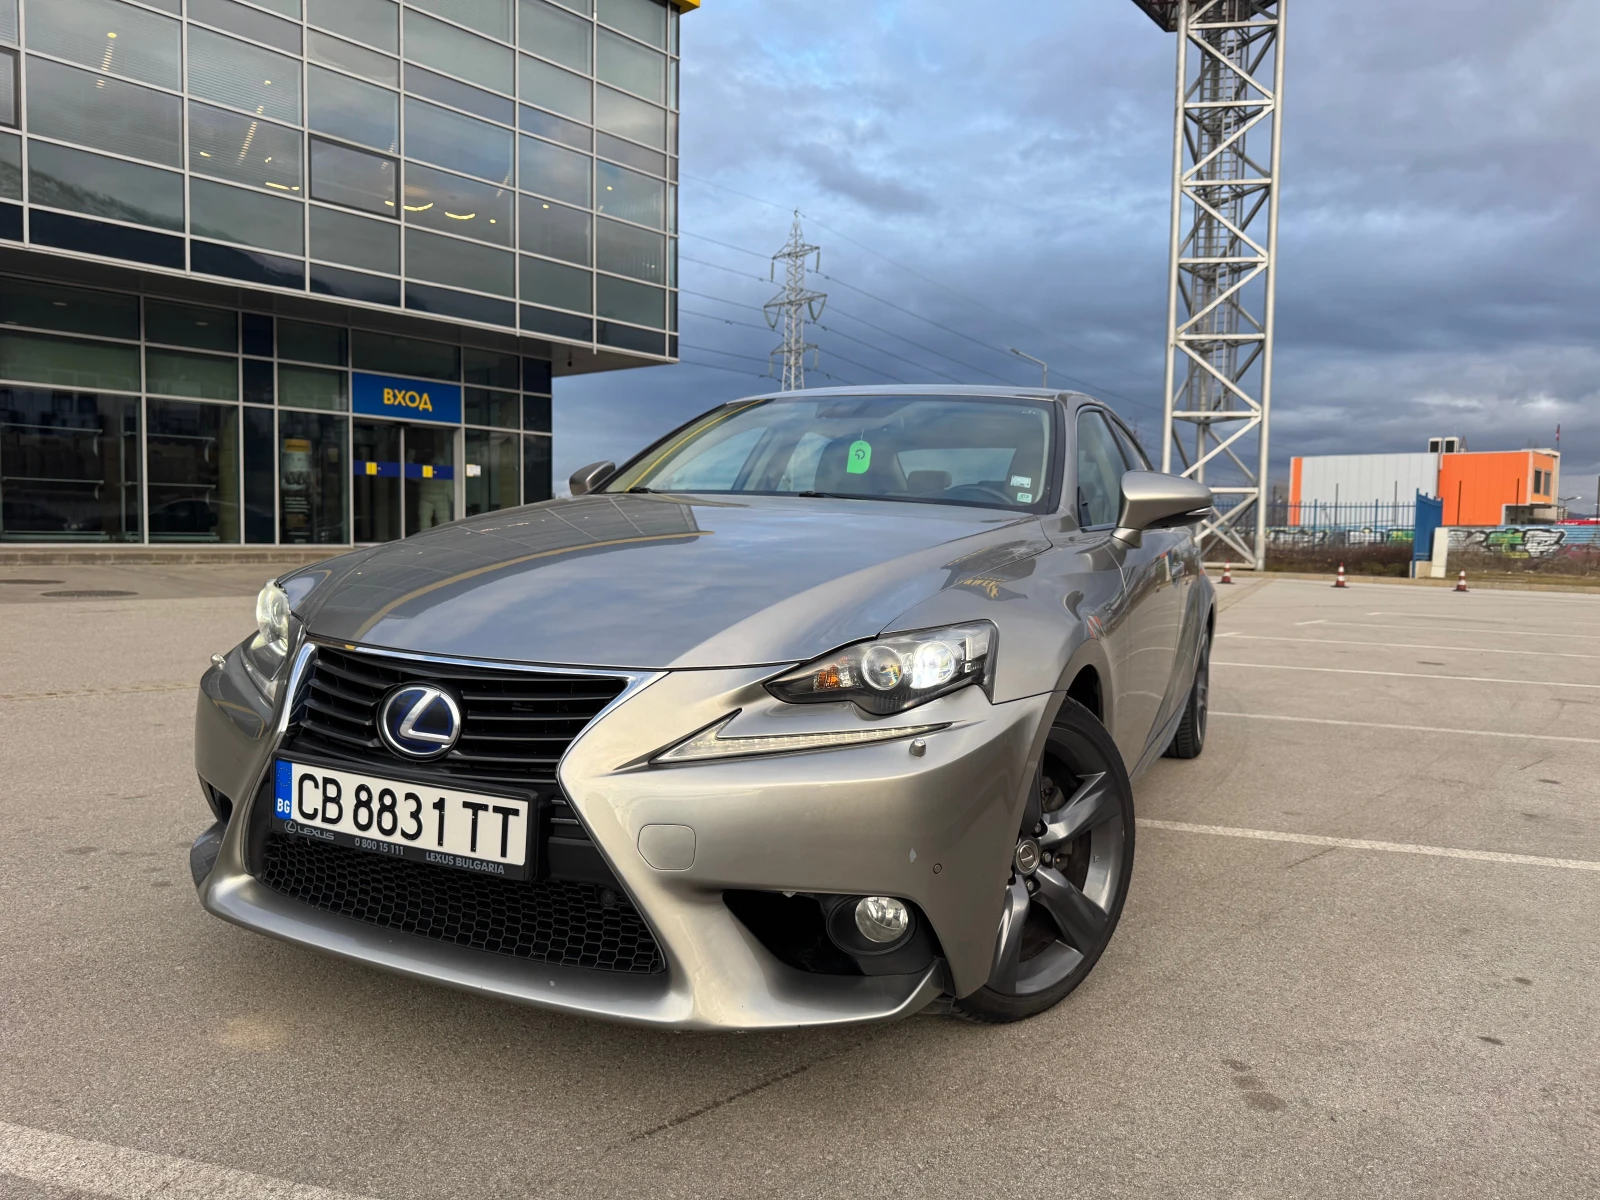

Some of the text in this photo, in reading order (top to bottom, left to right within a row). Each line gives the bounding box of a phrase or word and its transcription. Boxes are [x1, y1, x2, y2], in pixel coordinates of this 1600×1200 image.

[383, 388, 432, 412] ВХОД
[276, 798, 291, 814] BG
[352, 783, 446, 847] 8831
[298, 825, 335, 841] LEXUS
[426, 851, 505, 875] LEXUS BULGARIA
